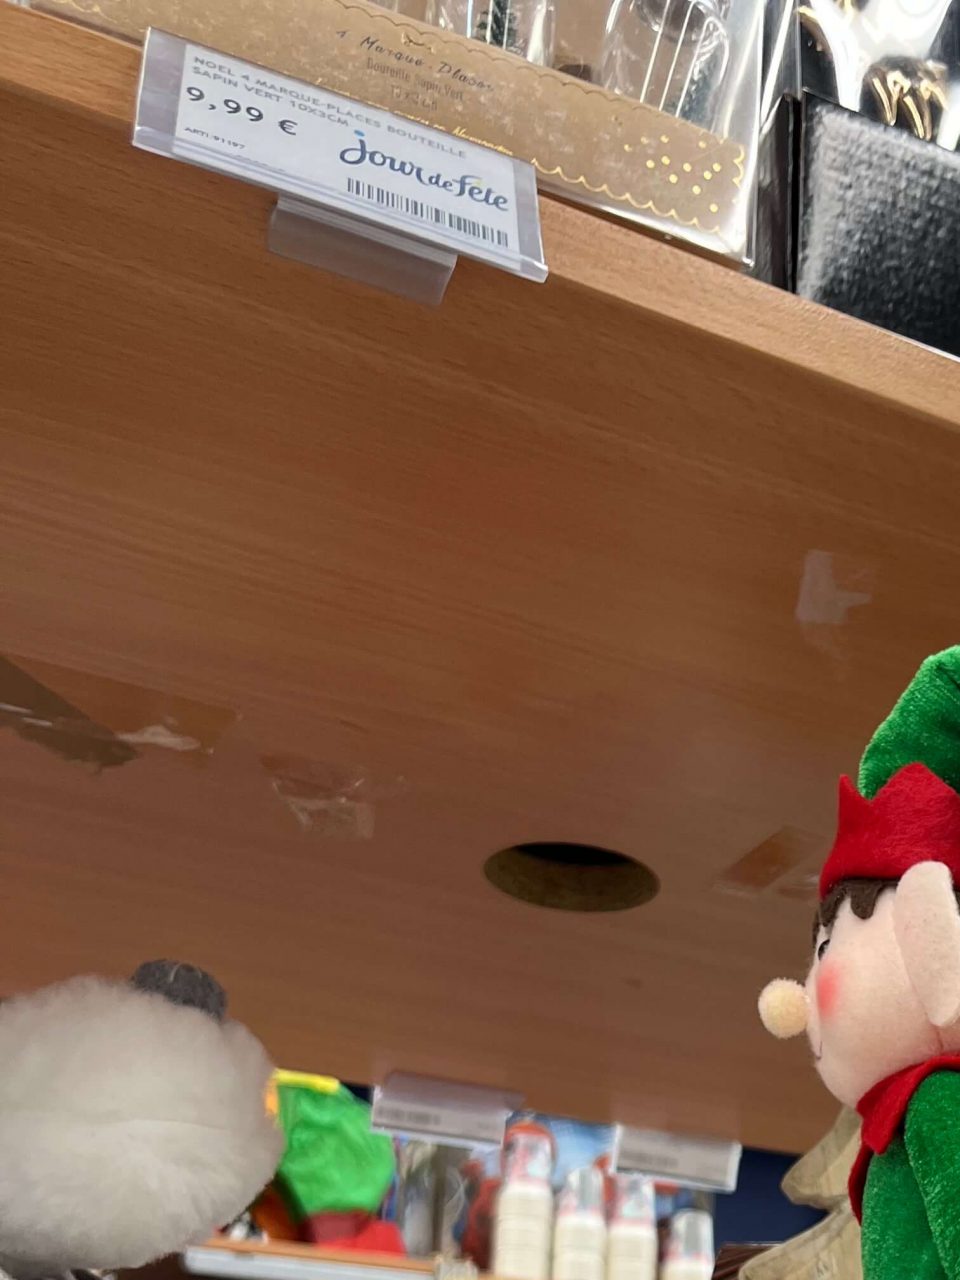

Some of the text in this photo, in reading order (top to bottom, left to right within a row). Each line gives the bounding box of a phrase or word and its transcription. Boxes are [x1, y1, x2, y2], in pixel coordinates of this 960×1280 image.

[192, 66, 239, 88] SAPIN
[244, 84, 283, 103] VERT
[194, 56, 235, 77] NOEL
[242, 74, 251, 82] 4
[387, 125, 467, 159] BOUTEILLE
[186, 86, 299, 136] 9,99 €
